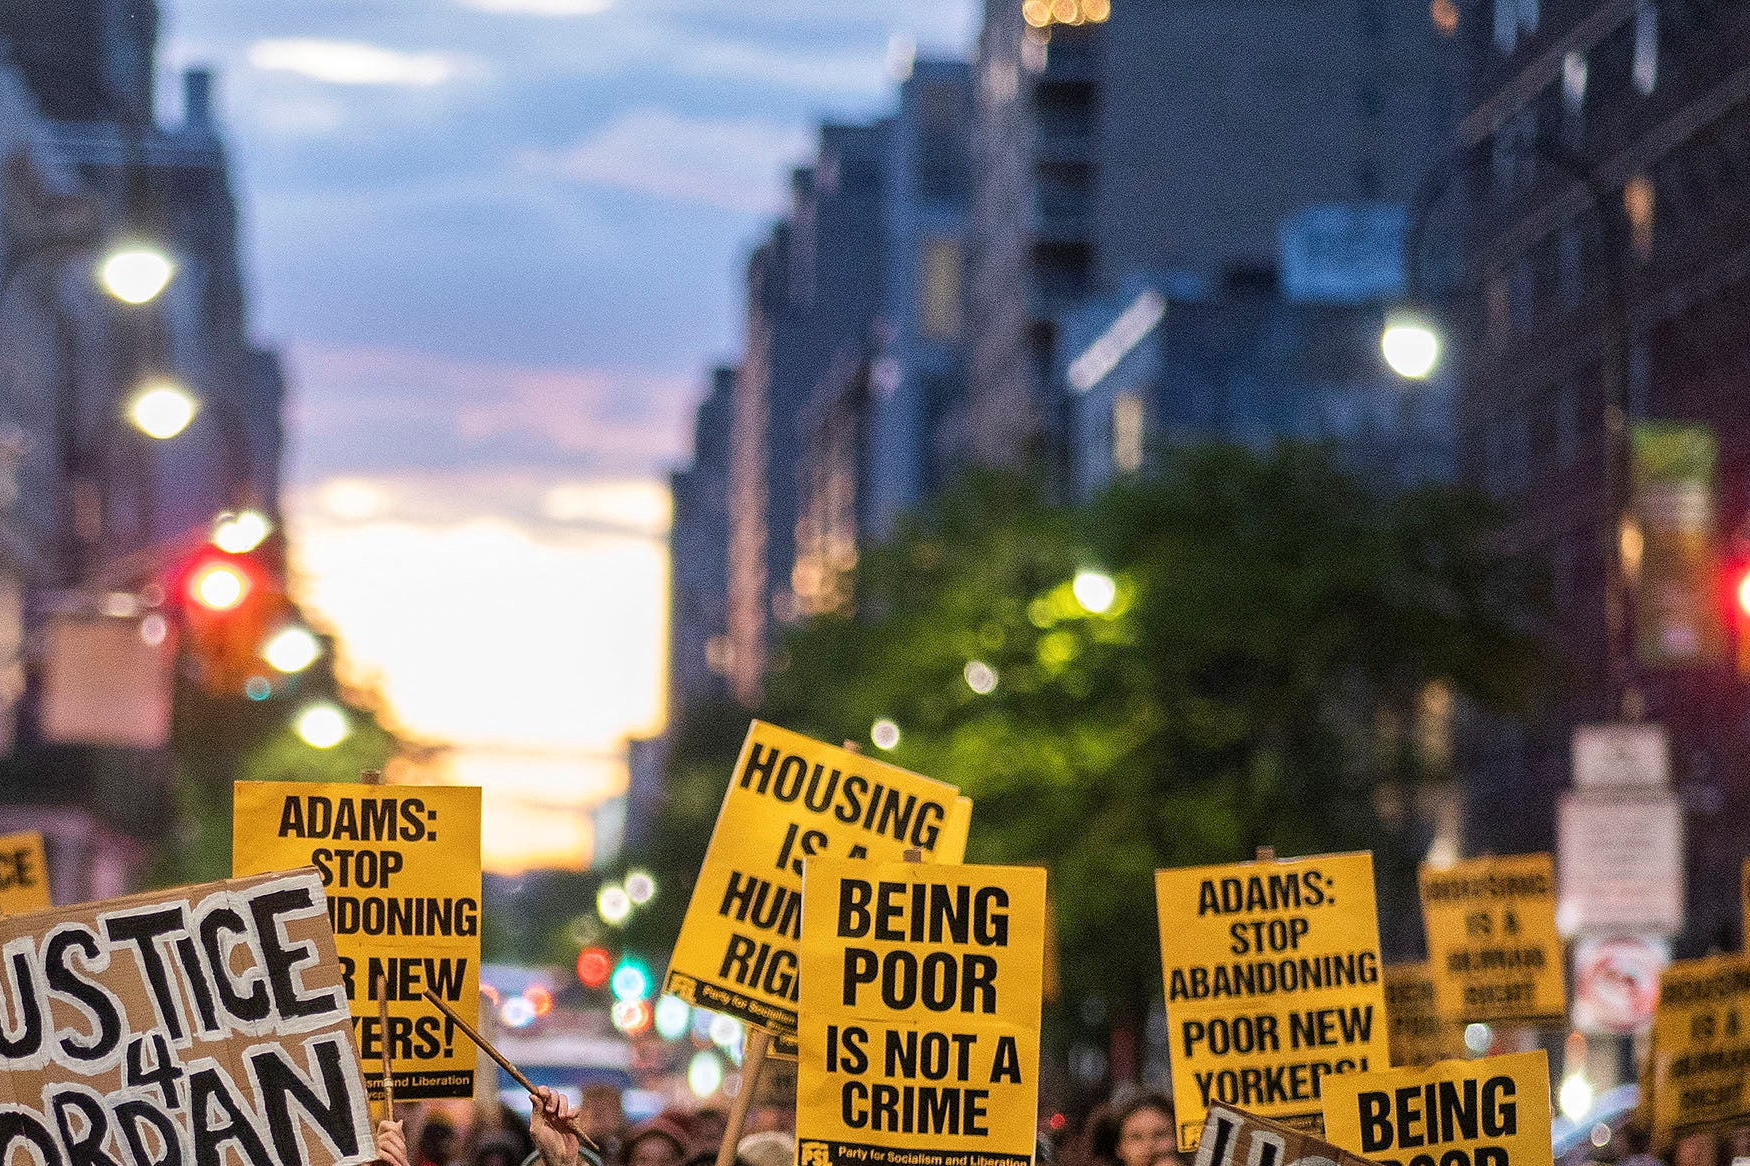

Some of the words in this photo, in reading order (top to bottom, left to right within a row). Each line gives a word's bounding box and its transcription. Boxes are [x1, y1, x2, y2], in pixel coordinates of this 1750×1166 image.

[278, 796, 437, 842] ADAMS:
[739, 742, 945, 852] HOUSING
[312, 849, 403, 889] STOP
[776, 823, 829, 877] IS
[838, 878, 1009, 947] BEING
[1198, 871, 1334, 915] ADAMS:
[1230, 918, 1309, 956] STOP
[369, 958, 467, 1001] NEW
[842, 947, 998, 1014] POOR
[1170, 952, 1378, 1002] ABANDONING
[826, 1025, 869, 1076] IS
[884, 1030, 977, 1083] NOT
[989, 1035, 1021, 1085] A
[1182, 1015, 1279, 1058] POOR
[1290, 1005, 1373, 1049] NEW
[122, 1032, 188, 1110] 4
[412, 1075, 470, 1087] Liberation
[841, 1080, 989, 1137] CRIME
[1357, 1076, 1517, 1154] BEING
[838, 1146, 868, 1161] Party
[870, 1149, 885, 1161] for
[887, 1152, 942, 1166] Socialism
[945, 1154, 967, 1166] and
